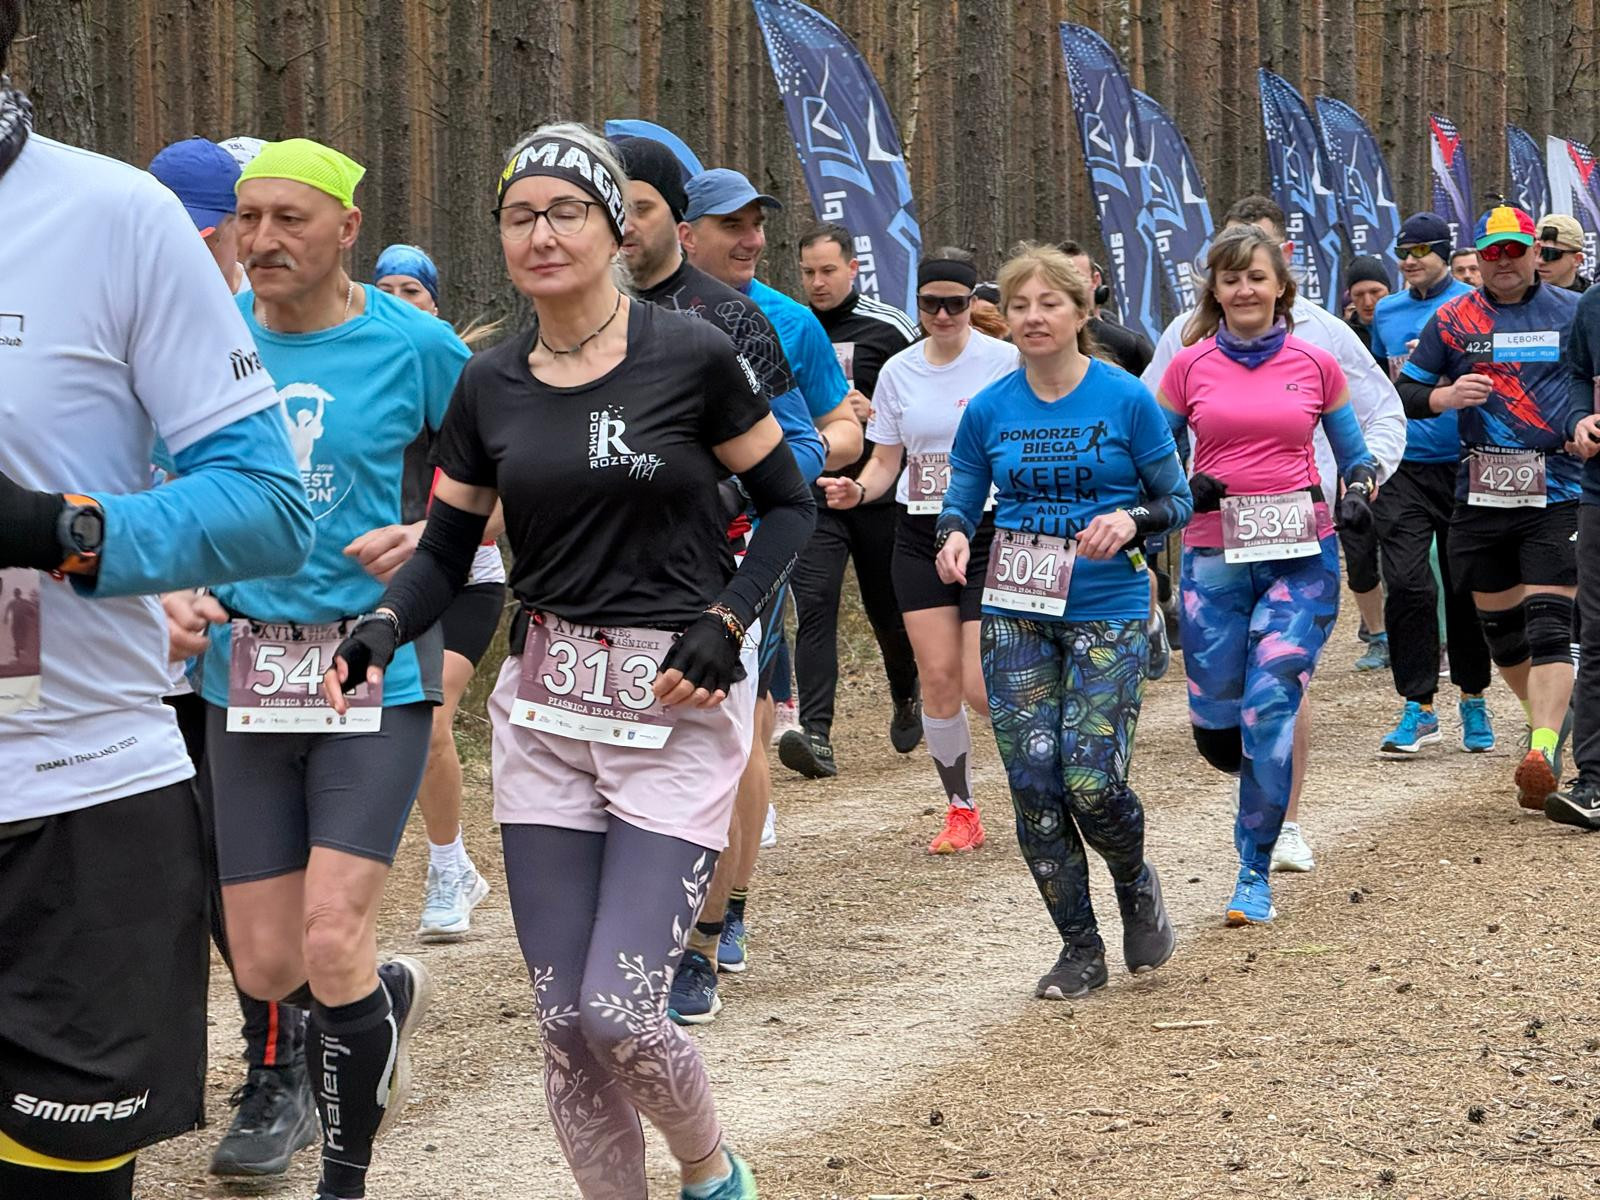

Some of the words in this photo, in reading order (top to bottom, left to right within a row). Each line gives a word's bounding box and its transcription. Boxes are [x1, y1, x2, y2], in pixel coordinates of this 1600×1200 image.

[1466, 341, 1492, 354] 42,2
[1507, 335, 1545, 345] LĘBORK
[1000, 427, 1081, 443] POMORZE
[1022, 441, 1077, 454] BIEGA
[920, 466, 954, 495] 51
[1008, 466, 1093, 489] KEEP
[1479, 466, 1535, 492] 429
[1036, 505, 1070, 516] AND
[1020, 516, 1087, 539] RUN
[1237, 504, 1306, 541] 534
[995, 546, 1057, 589] 504
[611, 635, 660, 651] IAŚNICKI
[250, 645, 357, 697] 54
[541, 639, 660, 711] 313
[591, 706, 640, 721] 19.04.2026
[11, 1088, 150, 1123] SMMASH
